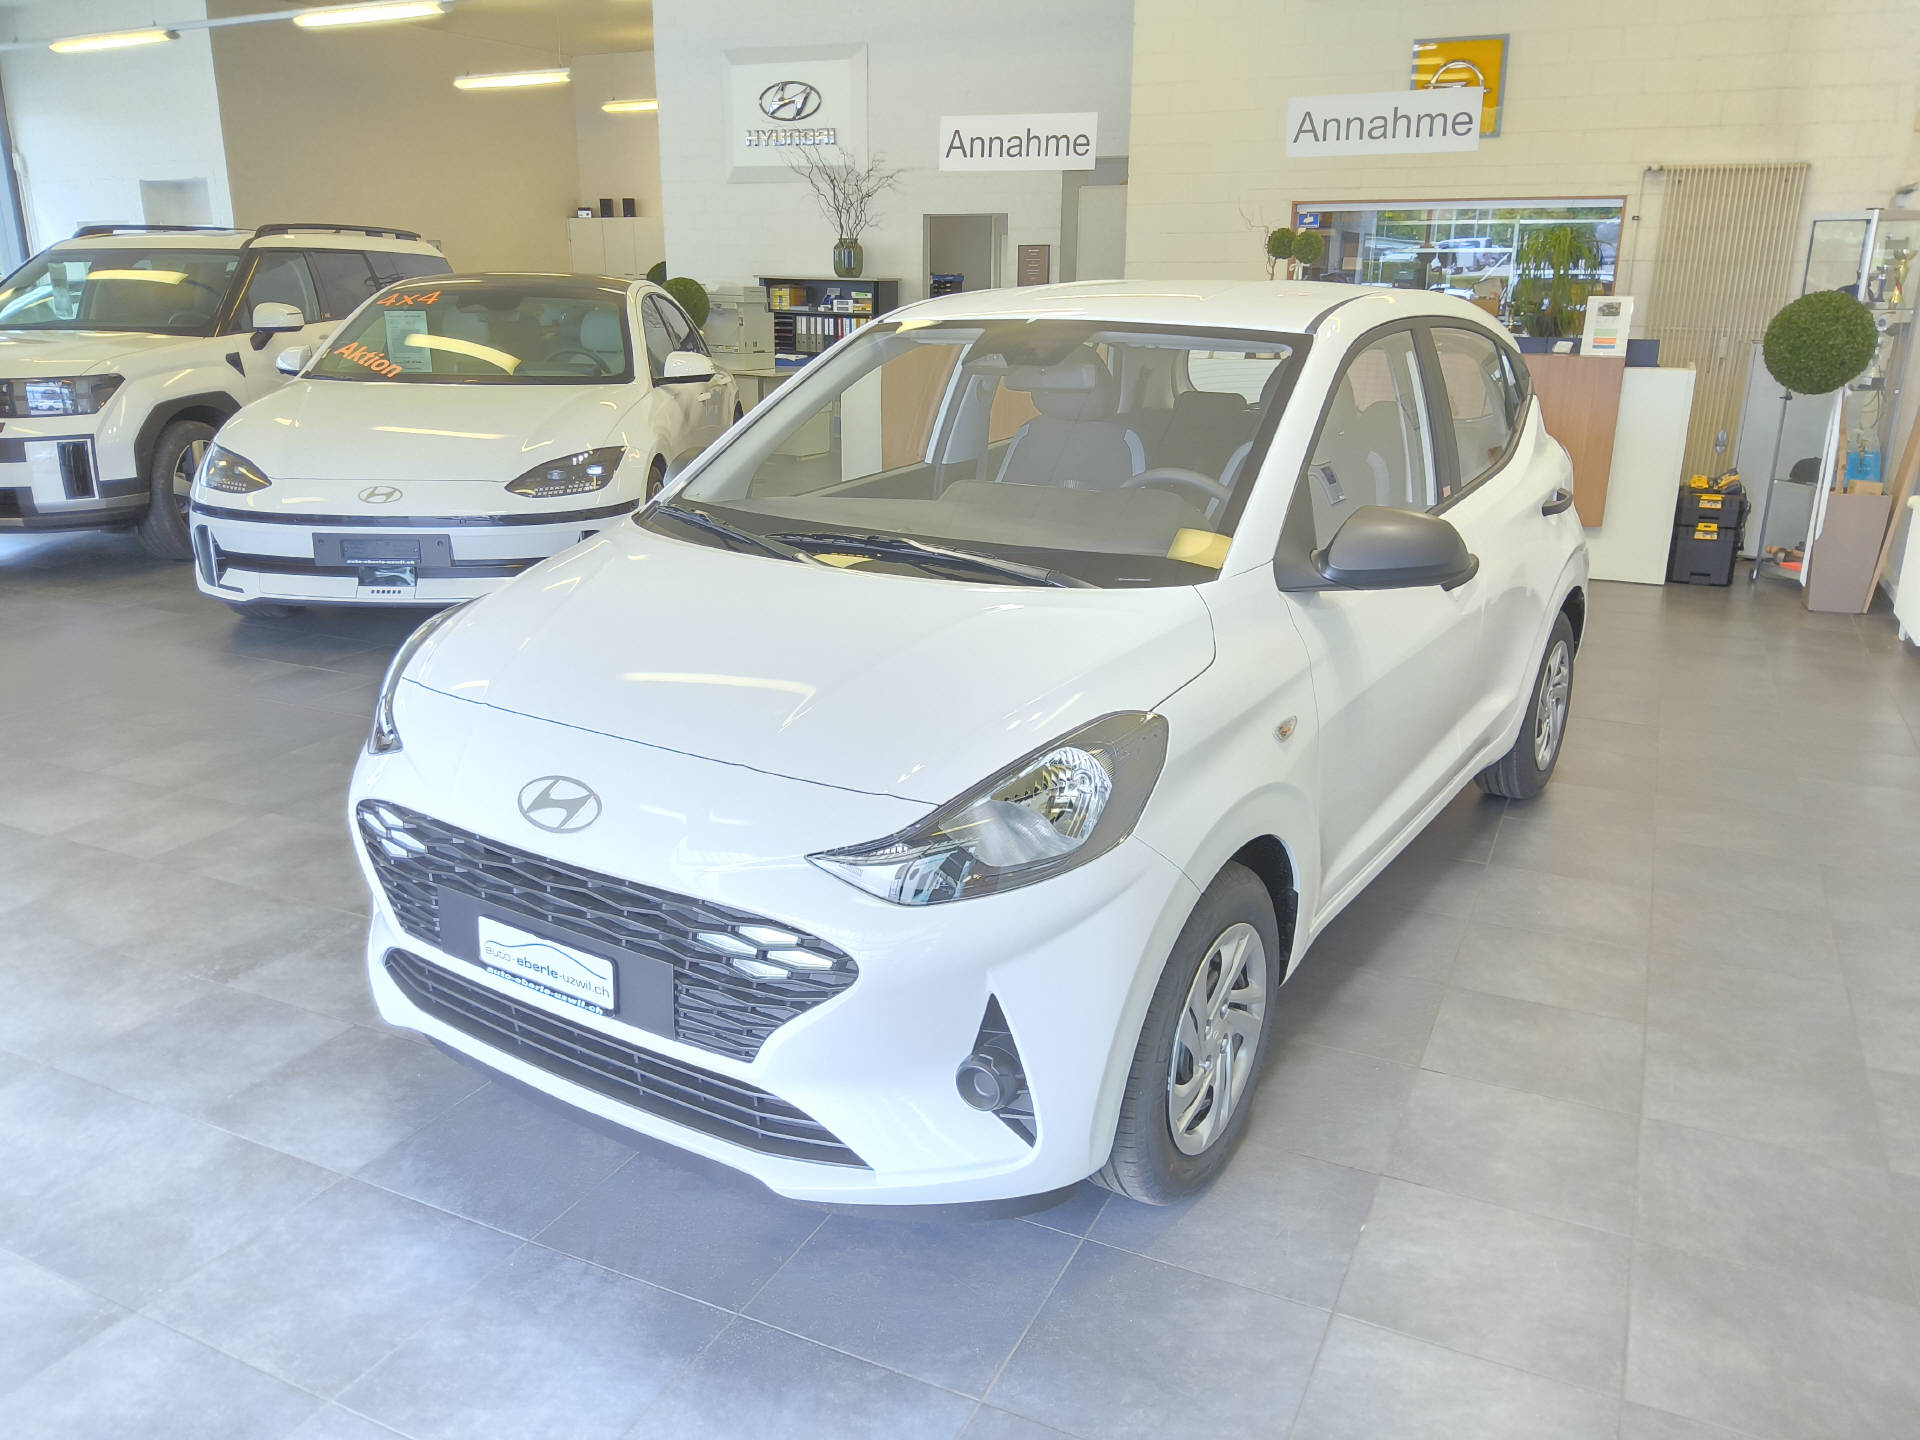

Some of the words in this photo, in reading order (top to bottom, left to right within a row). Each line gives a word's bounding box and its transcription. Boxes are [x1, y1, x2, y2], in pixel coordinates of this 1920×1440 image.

[745, 128, 835, 146] HYUNDAI
[1293, 107, 1474, 143] Annahme
[945, 128, 1090, 158] Annahme
[376, 291, 441, 307] 4x4
[335, 342, 403, 377] Aktion
